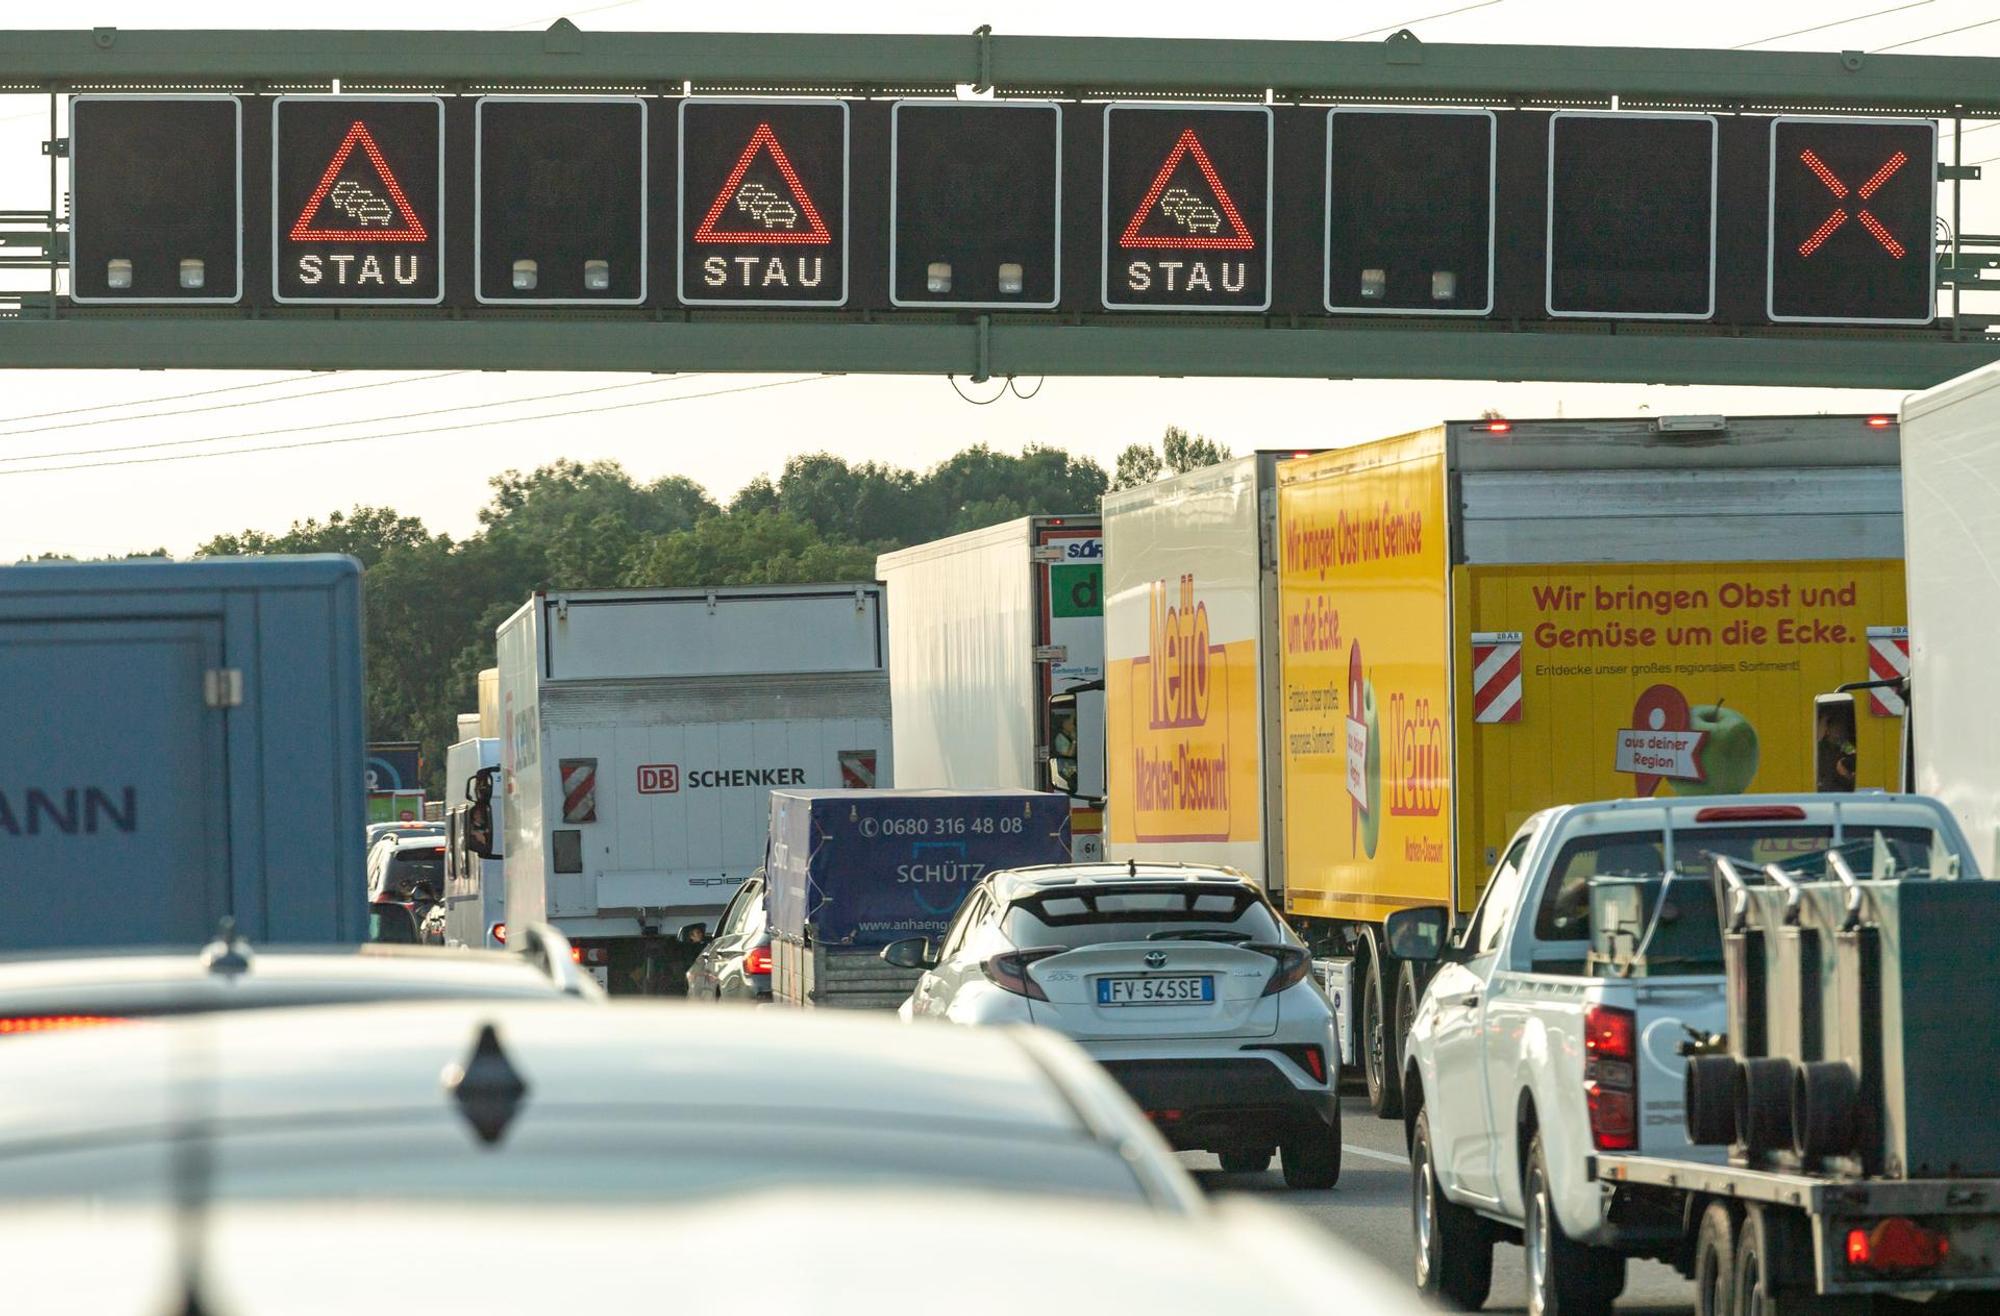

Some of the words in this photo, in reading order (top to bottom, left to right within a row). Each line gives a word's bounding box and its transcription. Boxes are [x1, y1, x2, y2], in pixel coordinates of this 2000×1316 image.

[298, 254, 418, 285] STAU
[704, 256, 823, 287] STAU
[1128, 261, 1245, 292] STAU
[1532, 585, 1586, 611] Wir
[1595, 584, 1709, 615] bringen
[1718, 582, 1791, 608] Obst
[1801, 581, 1857, 607] und
[1534, 622, 1657, 649] Gemüse
[1667, 626, 1713, 646] um
[1722, 619, 1768, 645] die
[1777, 618, 1857, 644] Ecke.
[1149, 573, 1210, 730] Netto
[1536, 664, 1593, 676] Entdecke
[1595, 665, 1628, 675] unser
[1632, 663, 1672, 677] großes
[1674, 662, 1736, 676] regionales
[1390, 693, 1442, 816] Netto
[1624, 737, 1645, 748] aus
[1647, 736, 1689, 751] deiner
[1633, 752, 1674, 769] Region
[643, 769, 674, 789] DB
[688, 768, 806, 788] SCHENKER
[882, 818, 928, 835] 0680
[934, 818, 966, 834] 316
[971, 817, 994, 834] 48
[1000, 817, 1023, 834] 08
[897, 860, 986, 883] SCHÜTZ
[1112, 981, 1135, 1000] FV
[1143, 980, 1200, 999] 545SE
